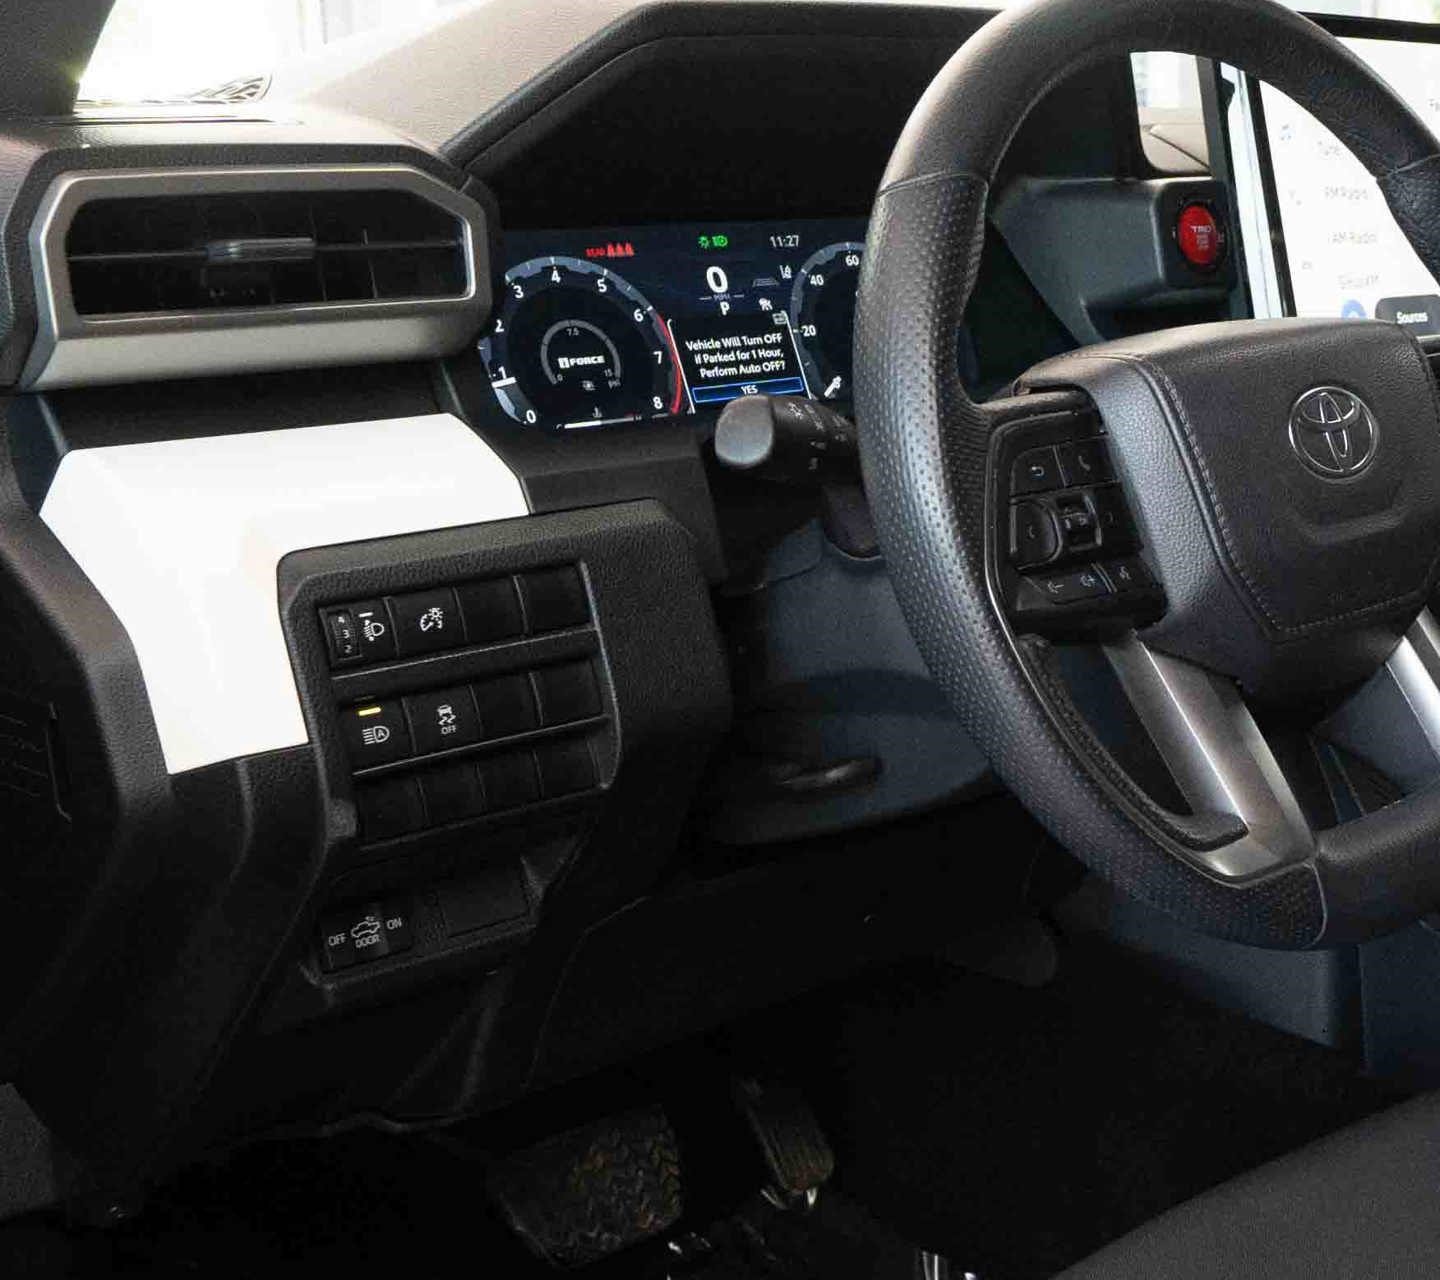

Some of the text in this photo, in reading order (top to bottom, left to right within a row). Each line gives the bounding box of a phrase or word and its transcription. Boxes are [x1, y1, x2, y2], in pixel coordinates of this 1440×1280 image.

[770, 235, 800, 248] 11:27
[845, 255, 860, 266] 60
[551, 271, 561, 283] 4
[706, 266, 729, 294] 0
[810, 275, 825, 287] 40
[513, 285, 524, 299] 3
[597, 279, 608, 293] 5
[633, 309, 644, 322] 6
[720, 302, 730, 316] P
[1397, 310, 1428, 325] Sources
[495, 320, 505, 333] 2
[803, 326, 817, 337] 20
[685, 333, 783, 351] Vehicle Will Turn OFF
[654, 351, 663, 364] 7
[694, 347, 784, 364] If Parked for 1 Hour,
[498, 367, 508, 380] 1
[700, 360, 786, 379] Perform Auto OFF?
[740, 385, 758, 395] YES
[653, 397, 663, 409] 8
[526, 410, 537, 423] 0
[441, 724, 457, 735] OFF
[386, 916, 403, 931] ON
[328, 932, 346, 947] OFF
[355, 934, 381, 949] DOOR
